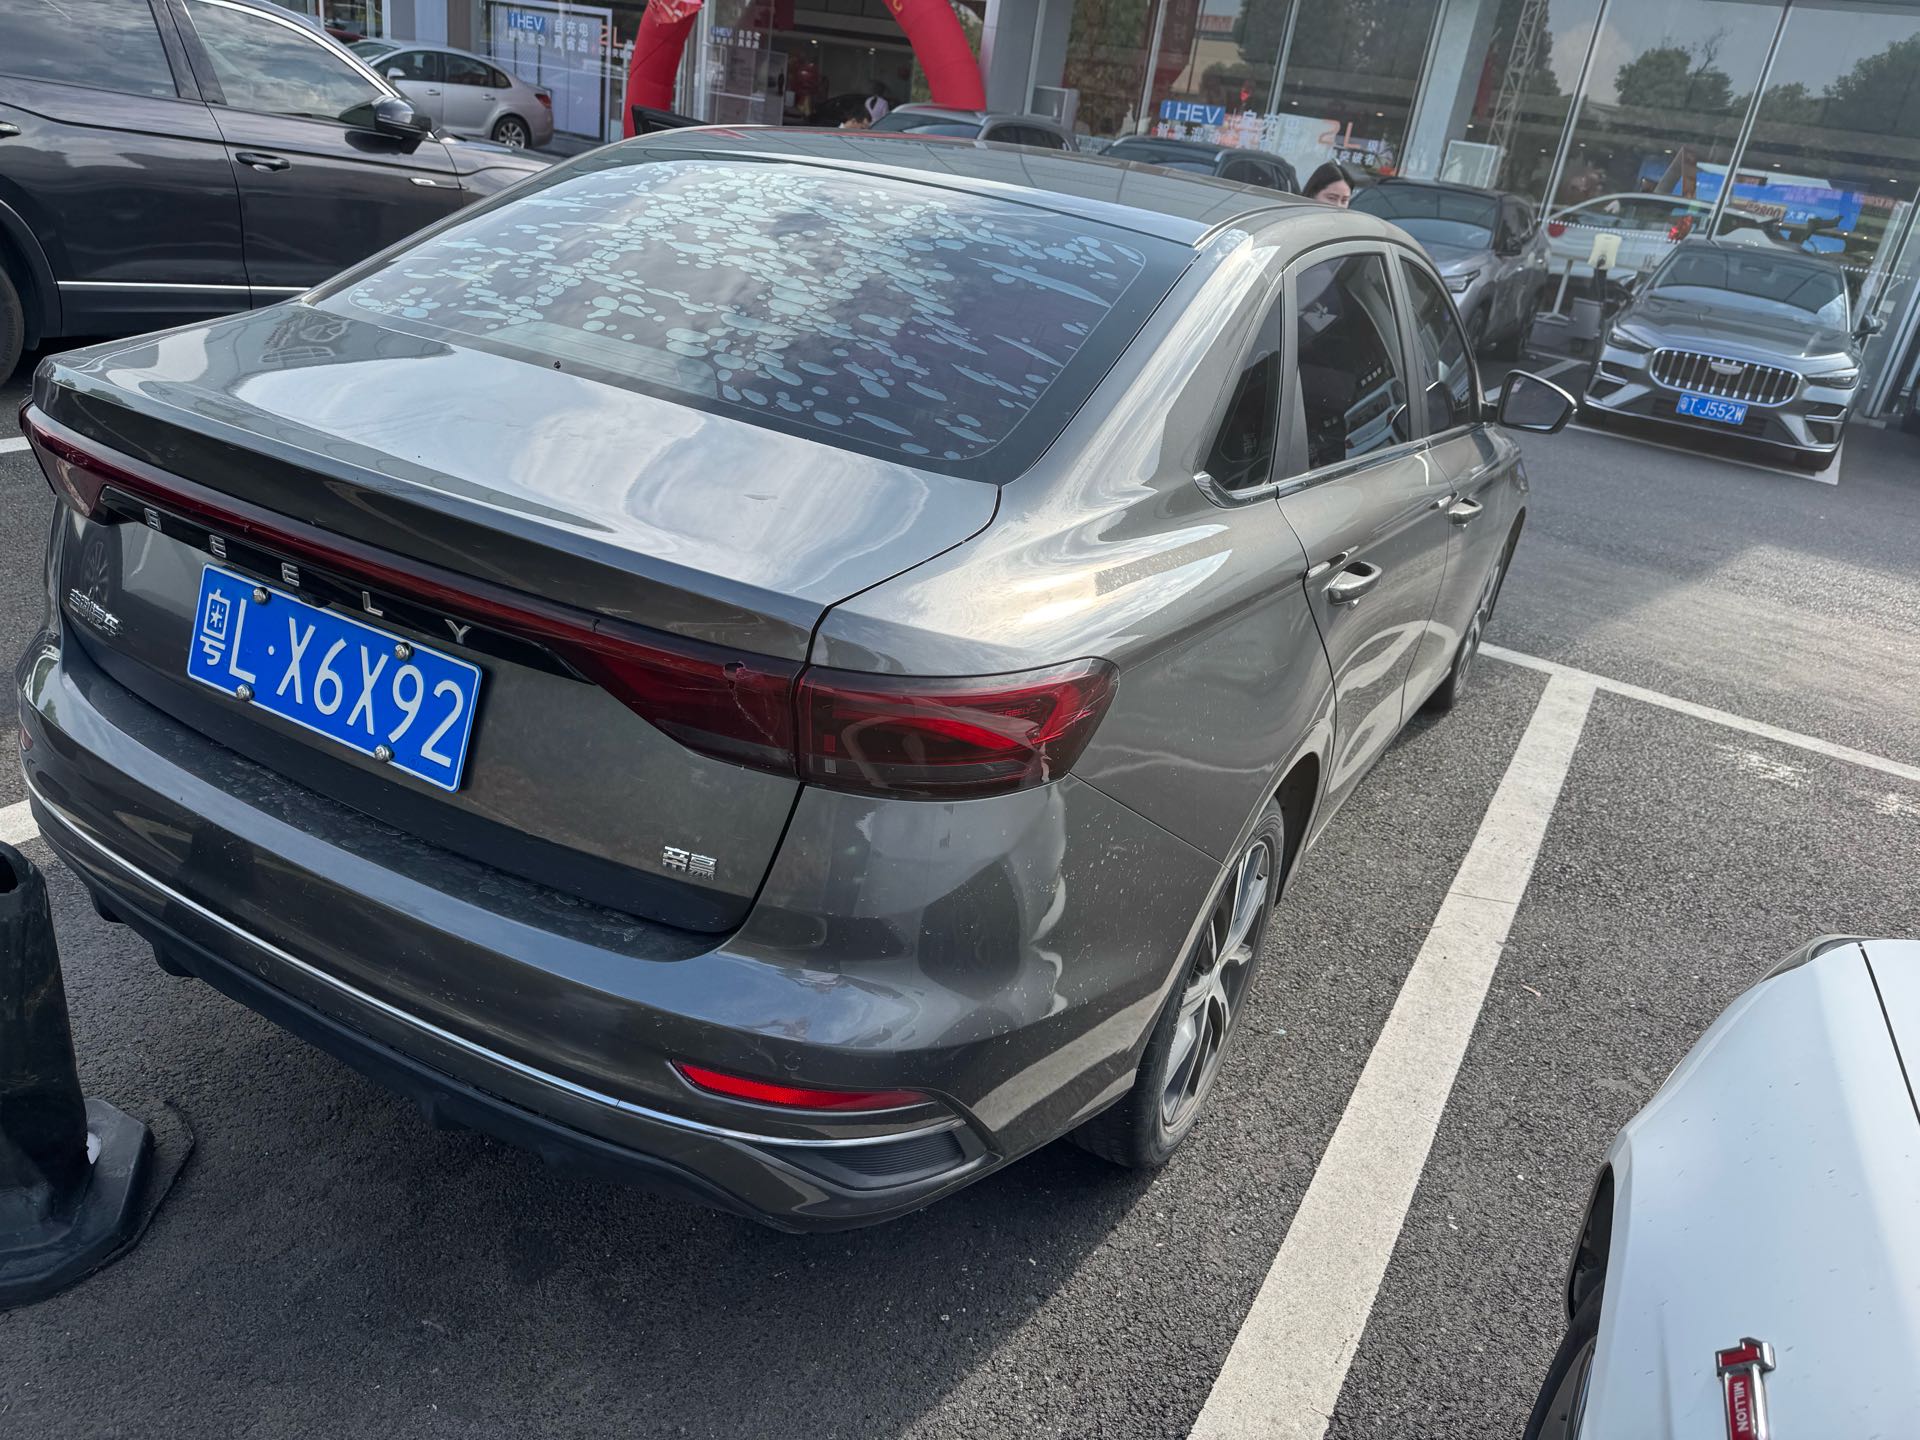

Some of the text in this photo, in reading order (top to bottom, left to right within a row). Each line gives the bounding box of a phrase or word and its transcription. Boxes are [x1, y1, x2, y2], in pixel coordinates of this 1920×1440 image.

[144, 507, 472, 645] GEELY
[199, 588, 465, 768] 粤L·X6X92
[662, 845, 718, 880] 帝豪
[1733, 1381, 1749, 1432] MILLION
